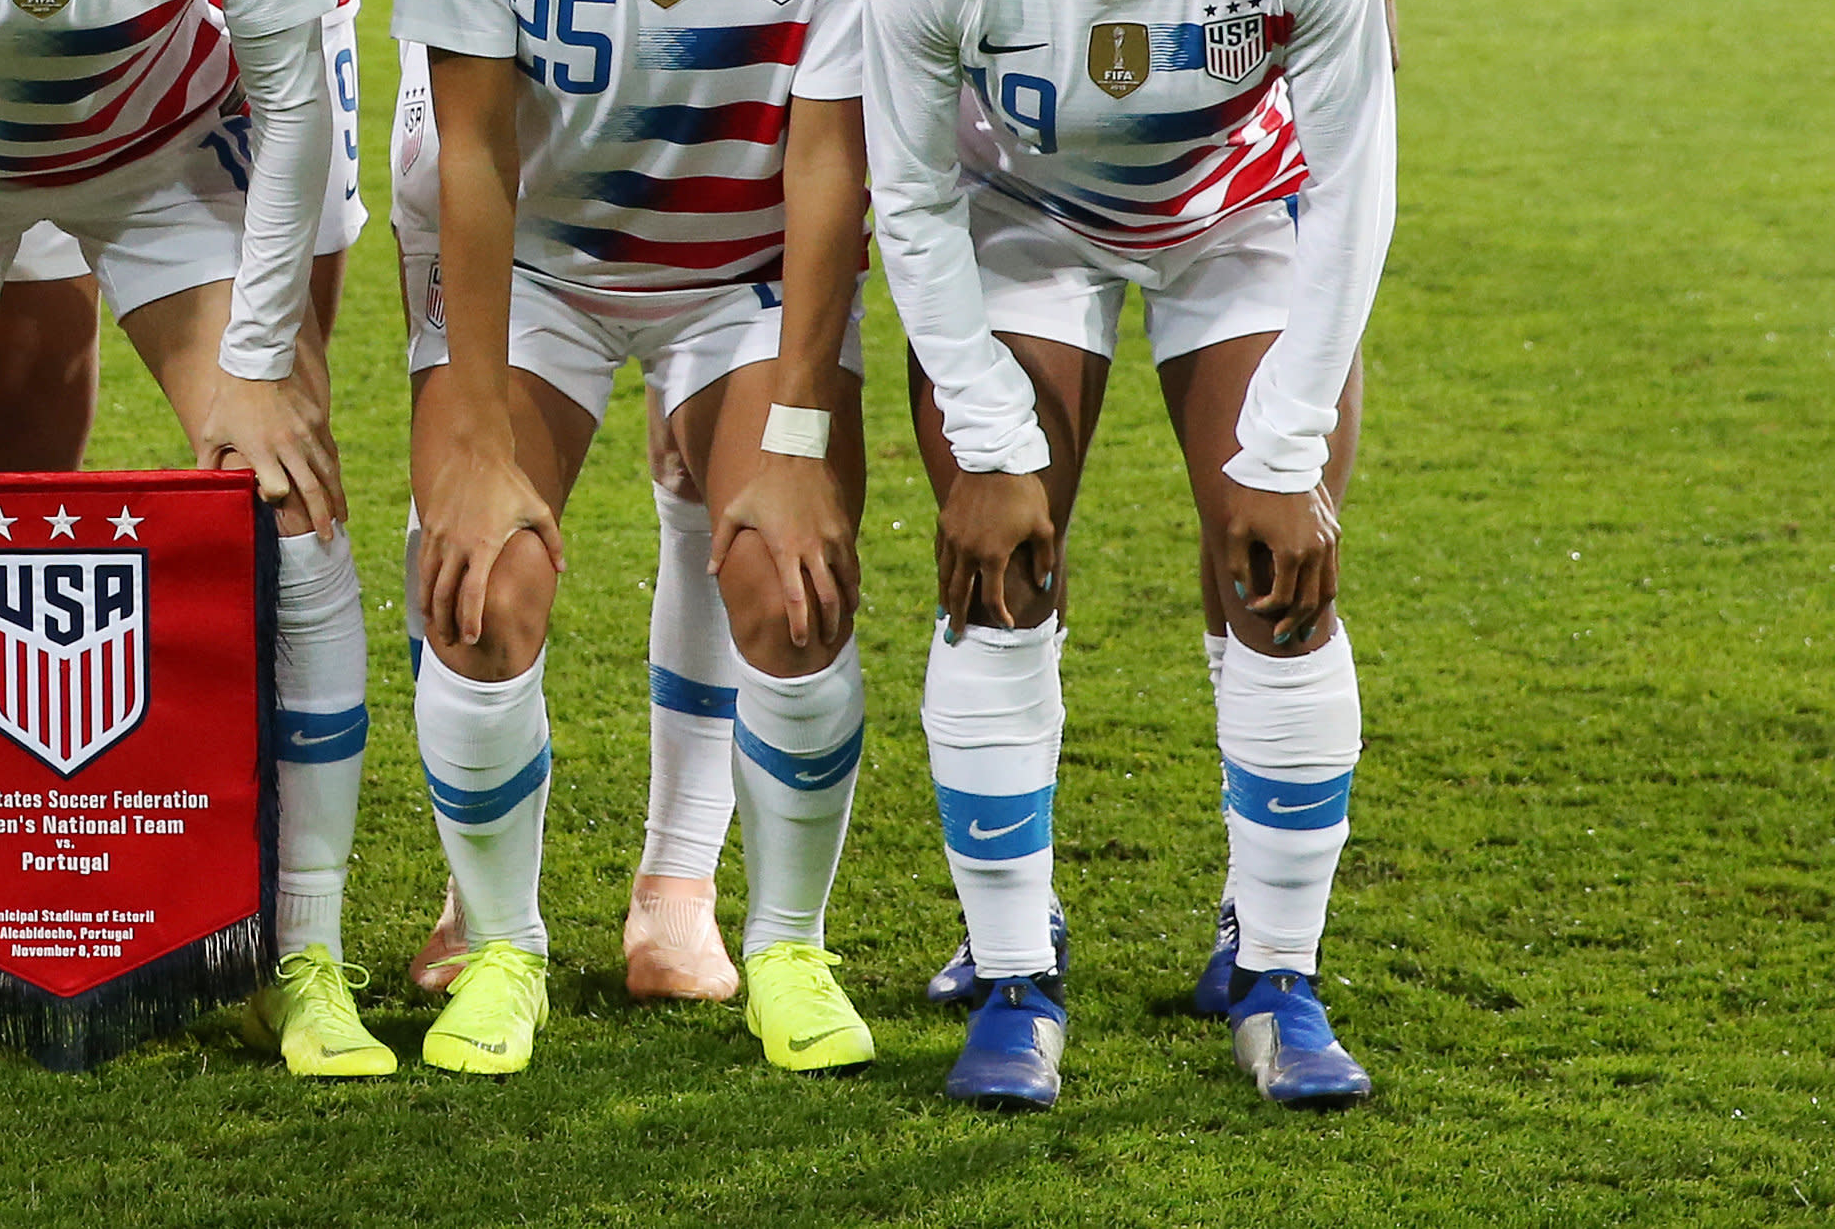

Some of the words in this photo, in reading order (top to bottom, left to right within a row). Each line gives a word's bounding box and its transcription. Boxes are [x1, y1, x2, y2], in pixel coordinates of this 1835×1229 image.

[1209, 20, 1260, 48] USA
[1104, 70, 1133, 81] FIFA
[961, 63, 1058, 155] 19
[48, 789, 107, 809] Soccer
[113, 790, 209, 809] Federation
[43, 815, 127, 835] National
[133, 816, 185, 835] Team
[55, 838, 76, 850] vs.
[22, 852, 110, 875] Portugal
[41, 909, 93, 924] Stadium
[95, 910, 110, 923] of
[112, 910, 155, 923] Estoril
[80, 927, 134, 942] Portugal
[11, 944, 76, 958] November
[78, 944, 91, 959] 8,
[93, 944, 122, 958] 2018
